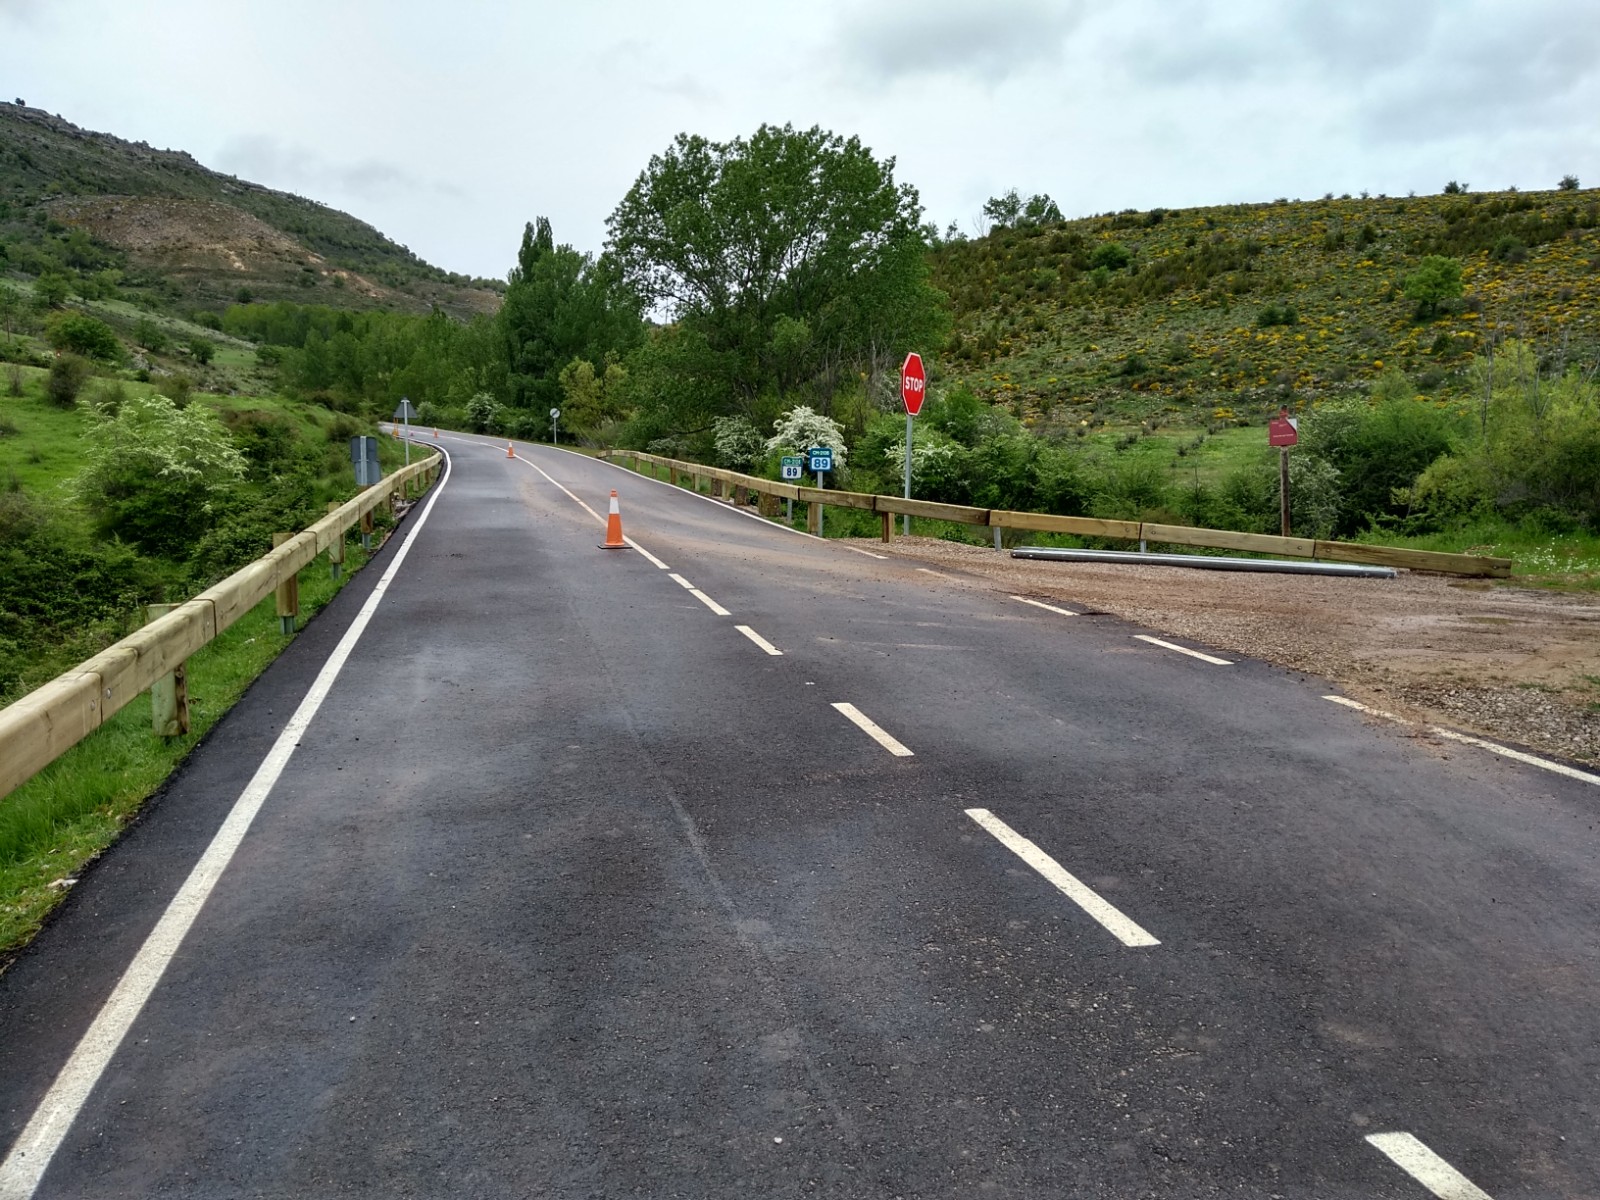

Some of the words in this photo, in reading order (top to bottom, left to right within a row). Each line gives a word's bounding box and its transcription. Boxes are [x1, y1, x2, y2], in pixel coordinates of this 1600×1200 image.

[905, 376, 923, 392] STOP
[814, 459, 828, 468] 89
[786, 467, 798, 477] 89
